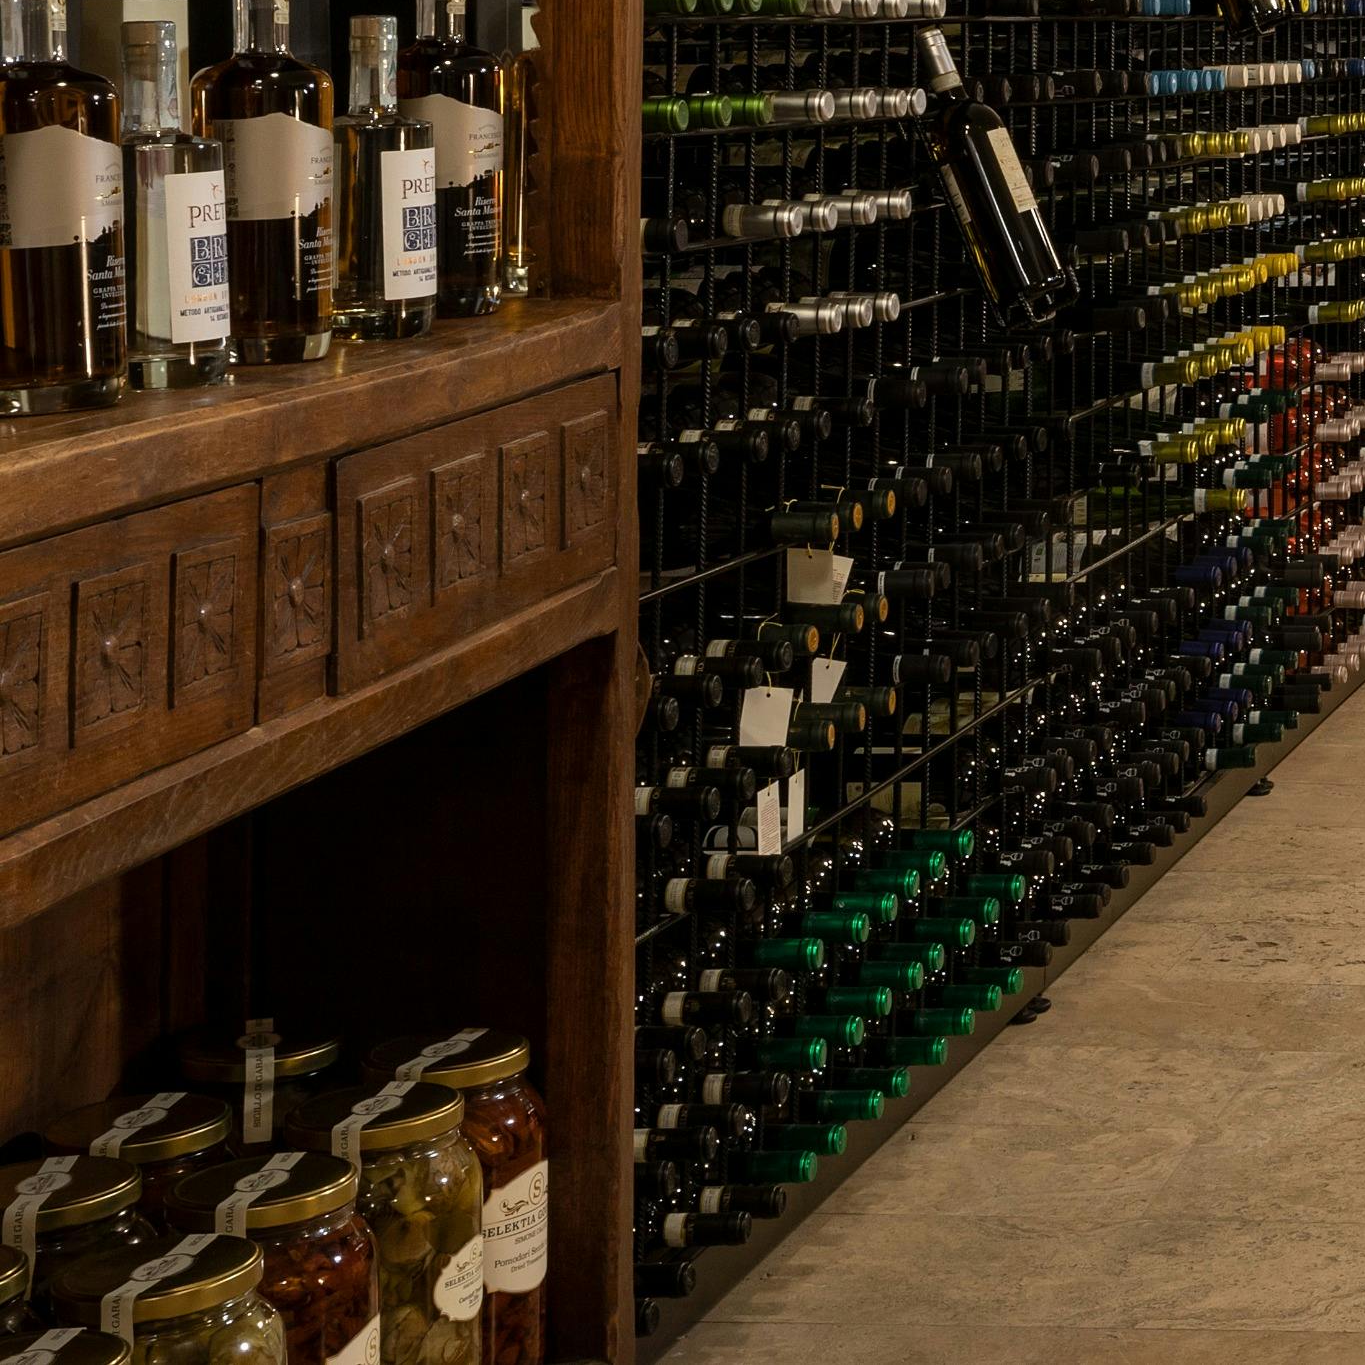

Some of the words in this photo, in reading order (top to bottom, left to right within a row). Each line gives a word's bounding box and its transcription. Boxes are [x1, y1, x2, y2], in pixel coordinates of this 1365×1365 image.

[454, 206, 481, 218] Santa
[298, 238, 322, 251] Santa
[86, 269, 113, 282] Santa
[482, 1214, 536, 1240] SELEKTIA
[494, 1248, 531, 1269] Pomodori
[444, 1269, 475, 1289] SELEKTIA
